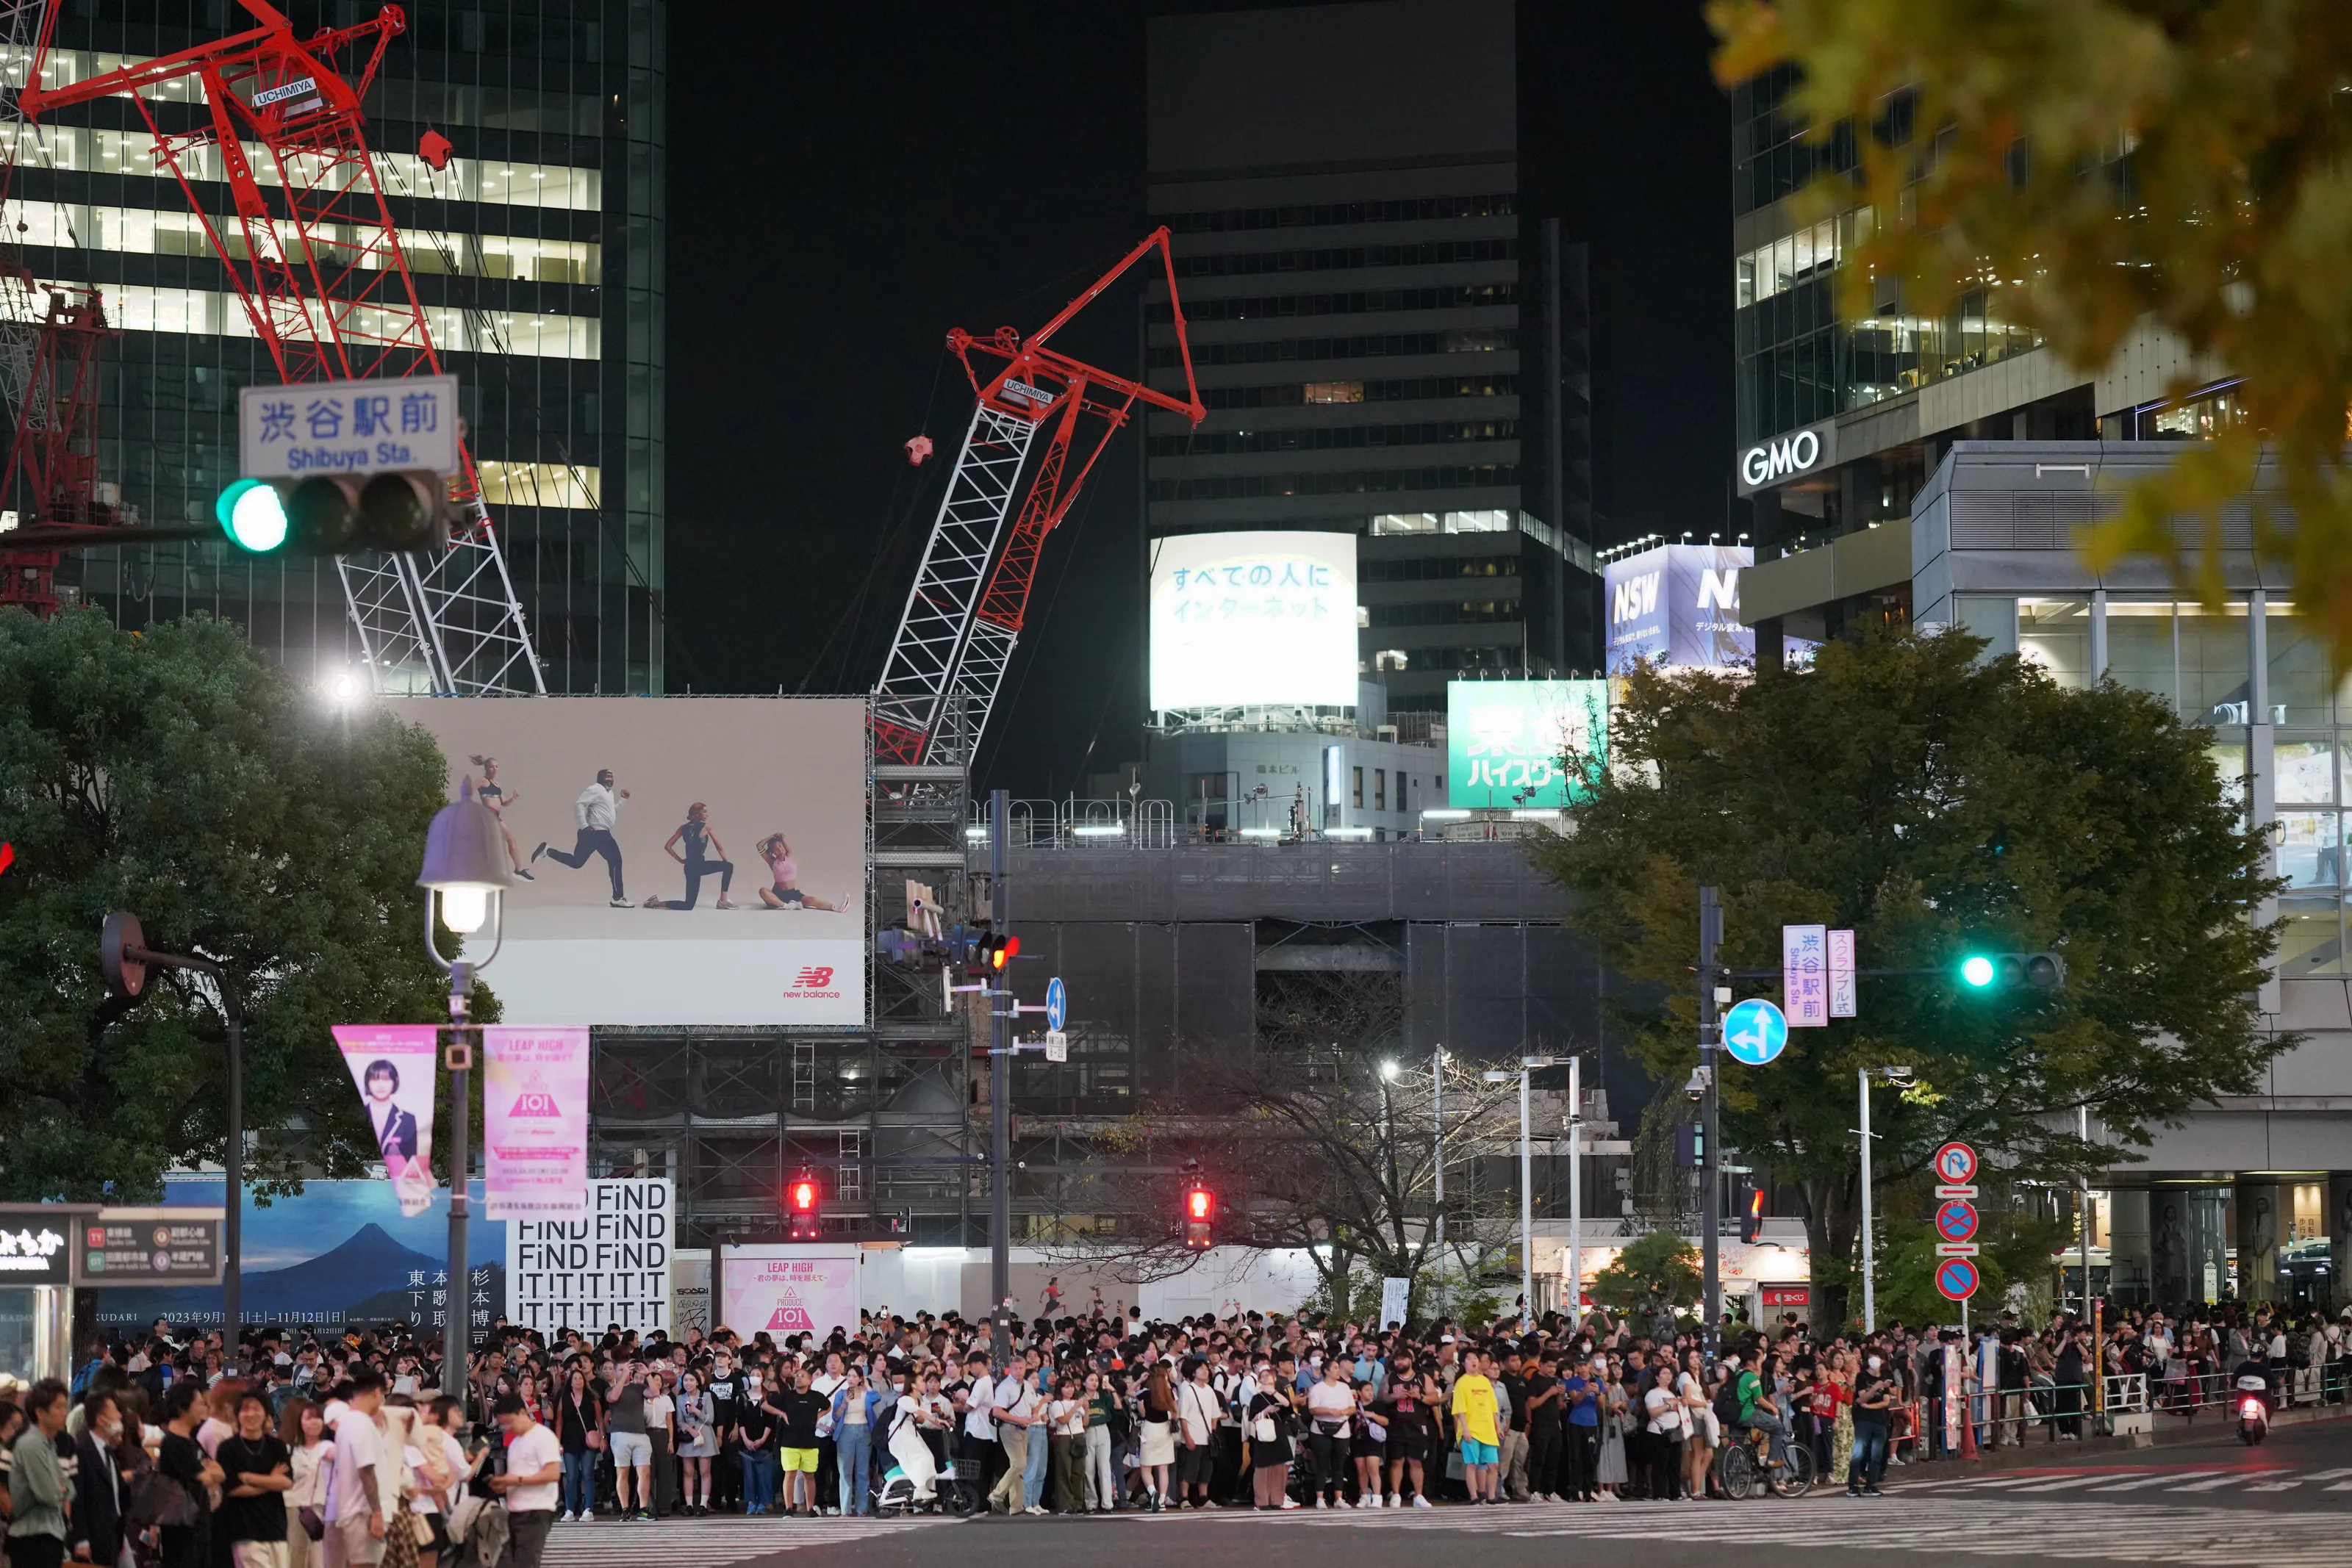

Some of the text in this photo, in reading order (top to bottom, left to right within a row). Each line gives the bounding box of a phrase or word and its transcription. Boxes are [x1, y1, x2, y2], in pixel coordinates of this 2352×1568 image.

[257, 80, 312, 104] UCHIMIYA
[1006, 380, 1049, 402] UCHIMIYA
[260, 391, 437, 443] 渋谷駅前
[287, 442, 417, 471] Shibuya Sta.
[1743, 431, 1818, 486] GMO
[1173, 563, 1329, 591] すべての人に
[1696, 569, 1740, 609] N
[1173, 595, 1328, 623] インターネット
[1613, 571, 1660, 625] NSW
[1790, 948, 1800, 1008] Shibuya Sta.
[1802, 935, 1821, 1018] 渋谷駅前
[1835, 935, 1849, 1013] スクランブル式
[509, 1040, 563, 1051] LEAP HIGH
[521, 1095, 550, 1111] 101
[597, 1184, 665, 1211] FiND
[91, 1233, 102, 1242] TY
[596, 1213, 665, 1240] FiND
[519, 1242, 665, 1270] FiND FiND
[767, 1263, 813, 1273] LEAP HIGH
[406, 1269, 426, 1328] 東下り
[470, 1269, 490, 1345] 杉本博司
[777, 1298, 803, 1306] PRODUCE
[1784, 1293, 1804, 1302] 宝くじ
[777, 1309, 803, 1323] 101
[1397, 1398, 1414, 1412] 91
